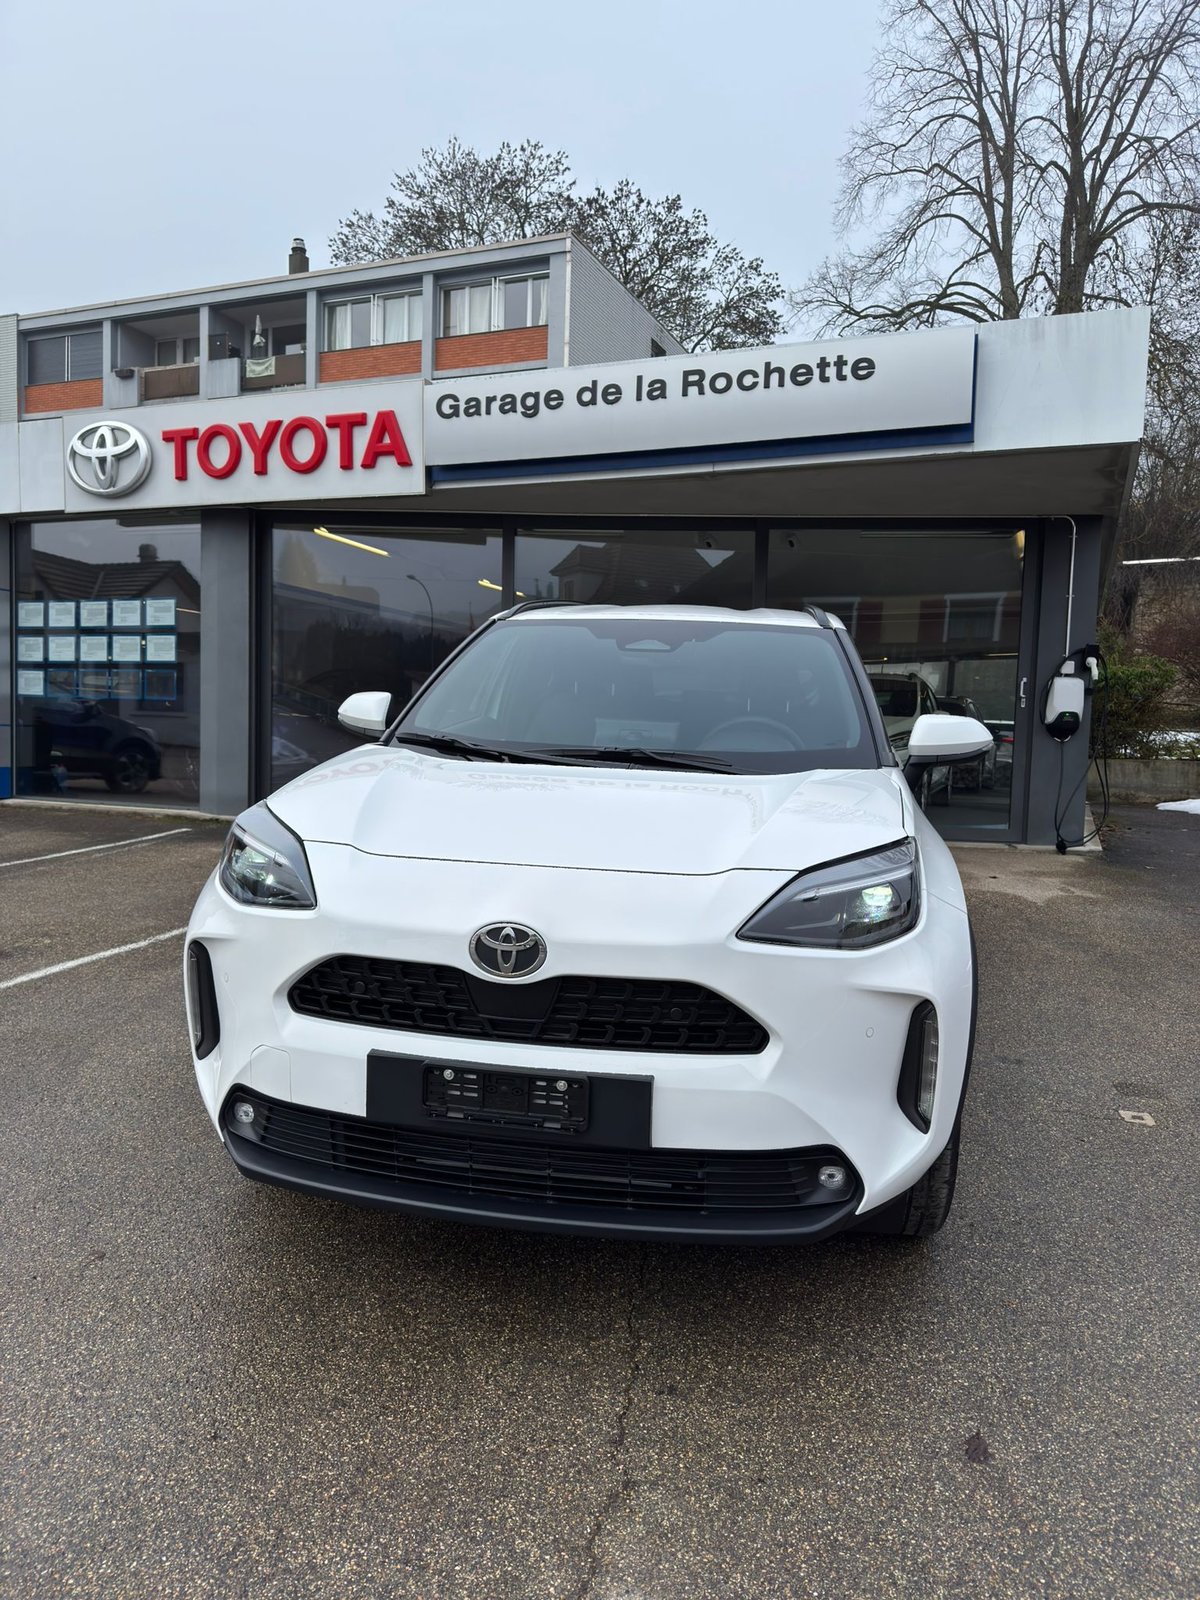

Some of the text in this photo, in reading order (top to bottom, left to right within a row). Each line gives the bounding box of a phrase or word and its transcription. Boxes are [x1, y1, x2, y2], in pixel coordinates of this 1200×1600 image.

[435, 354, 876, 420] Garage de la Rochette
[162, 410, 413, 481] TOYOTA
